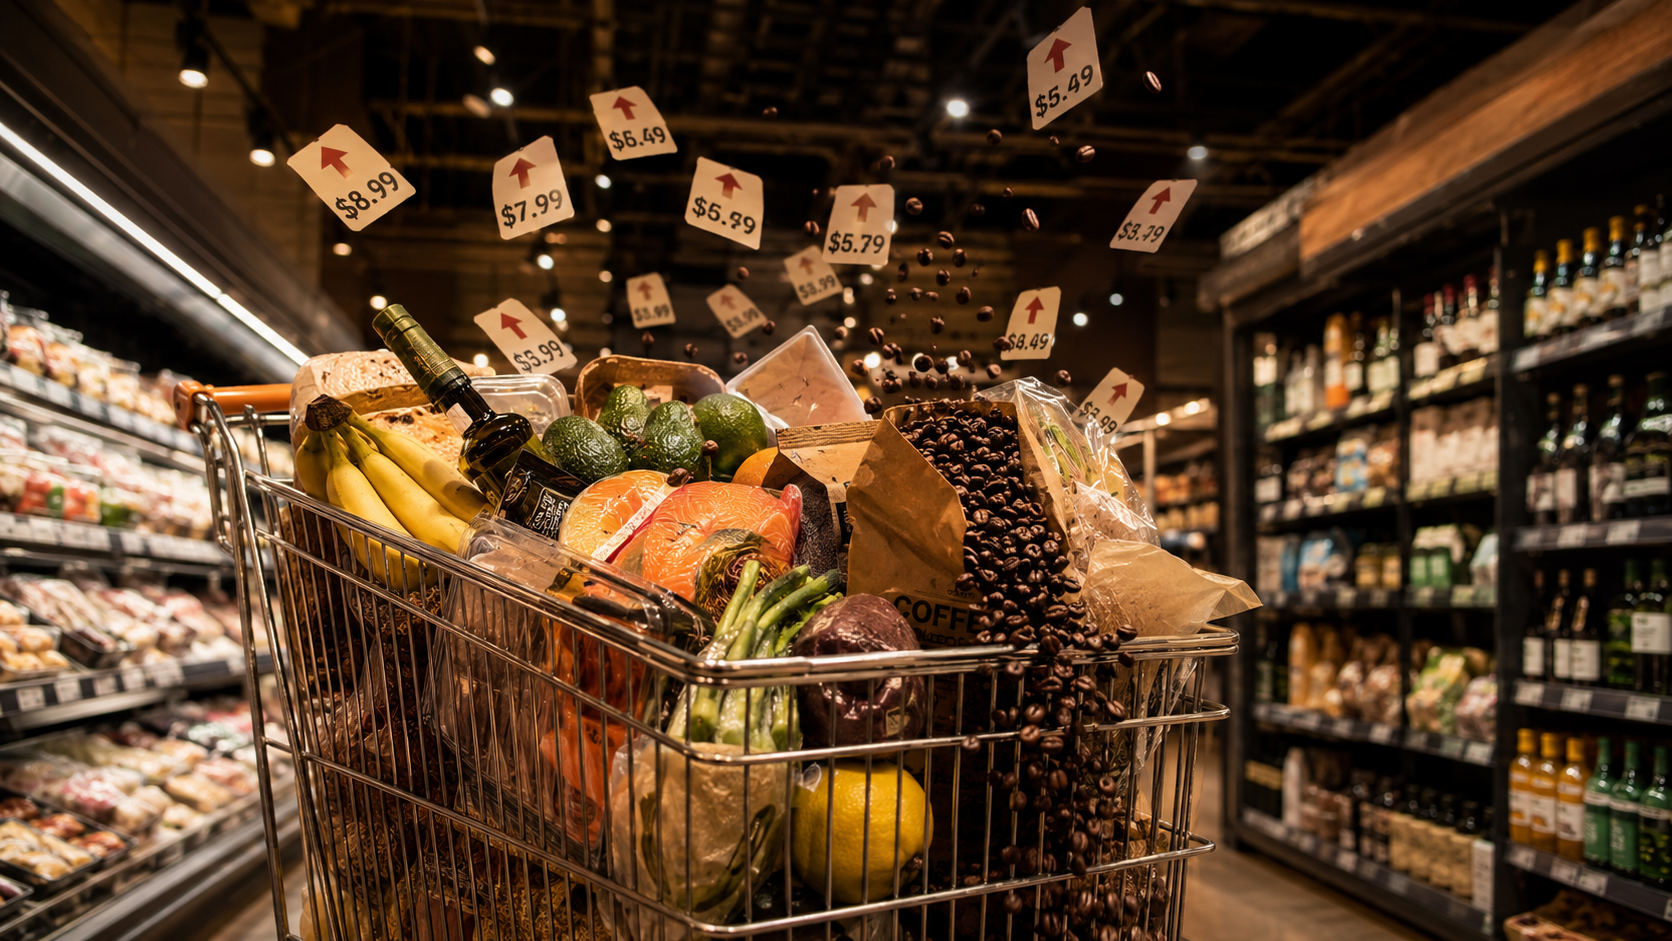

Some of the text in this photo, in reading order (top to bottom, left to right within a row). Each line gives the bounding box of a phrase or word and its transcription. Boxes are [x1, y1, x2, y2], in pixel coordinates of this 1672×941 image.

[1035, 65, 1093, 118] $5.49
[335, 171, 399, 220] $8.99
[501, 189, 562, 229] $7.99
[828, 231, 885, 255] $5.79
[513, 340, 563, 373] $5.99
